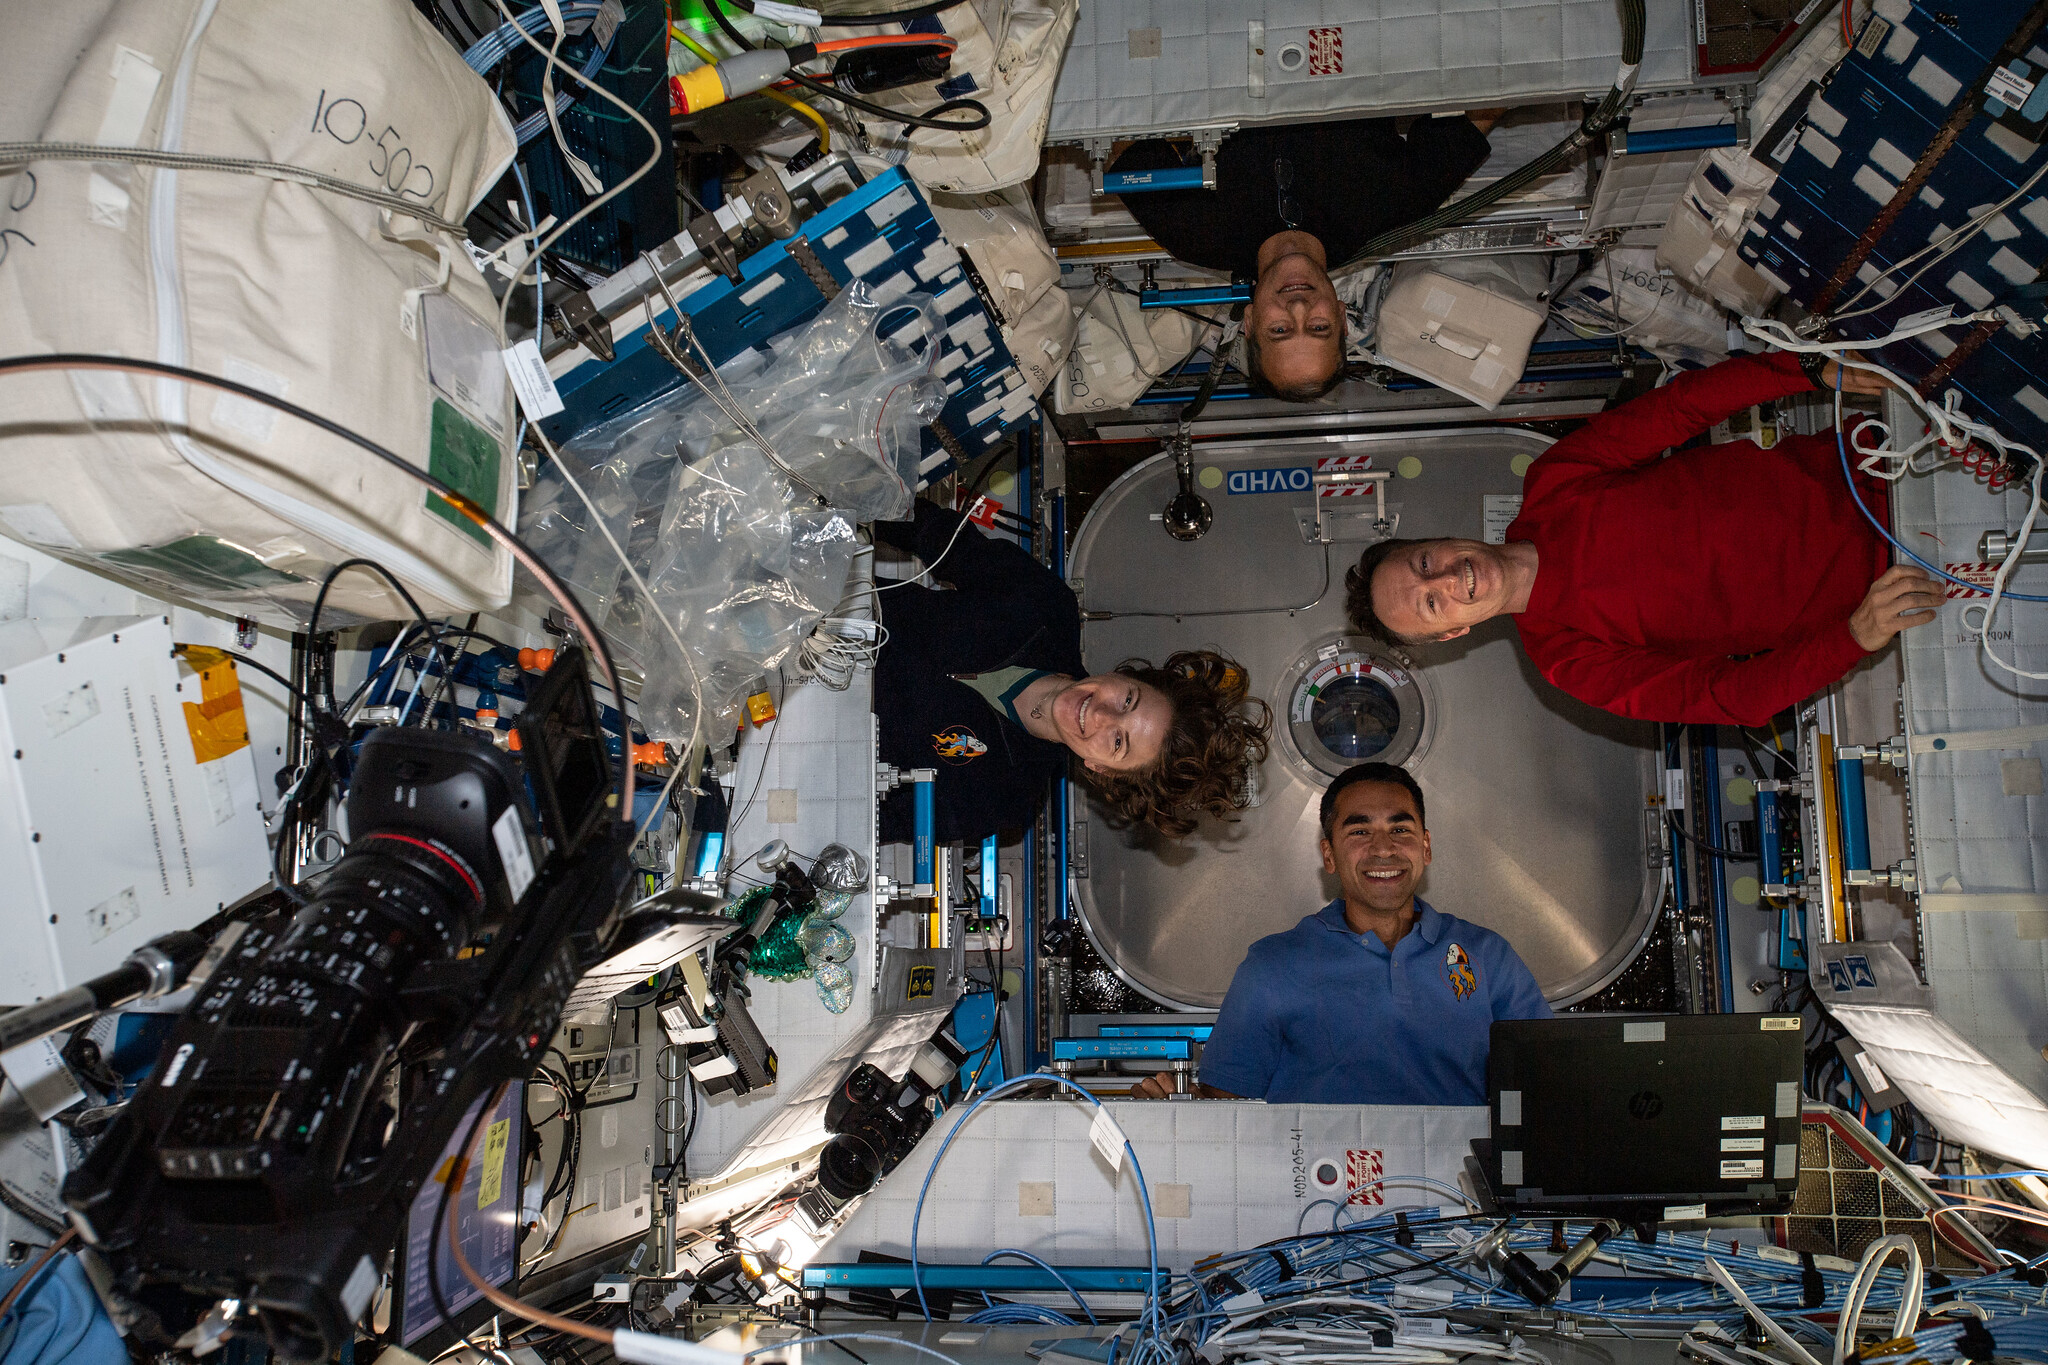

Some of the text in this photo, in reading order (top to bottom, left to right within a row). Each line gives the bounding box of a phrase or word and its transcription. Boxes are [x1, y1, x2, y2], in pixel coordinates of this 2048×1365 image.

[1229, 470, 1308, 491] OVHD
[1298, 685, 1310, 712] LATCHED
[123, 687, 132, 710] THIS
[128, 712, 137, 734] BOX
[133, 736, 143, 758] HAS
[140, 769, 154, 821] LOCATION
[151, 823, 171, 896] REQUIREMENT
[150, 695, 168, 760] COORDINATE
[173, 804, 186, 845] BEFORE
[182, 847, 194, 888] MOVING
[886, 1106, 903, 1122] Nikon
